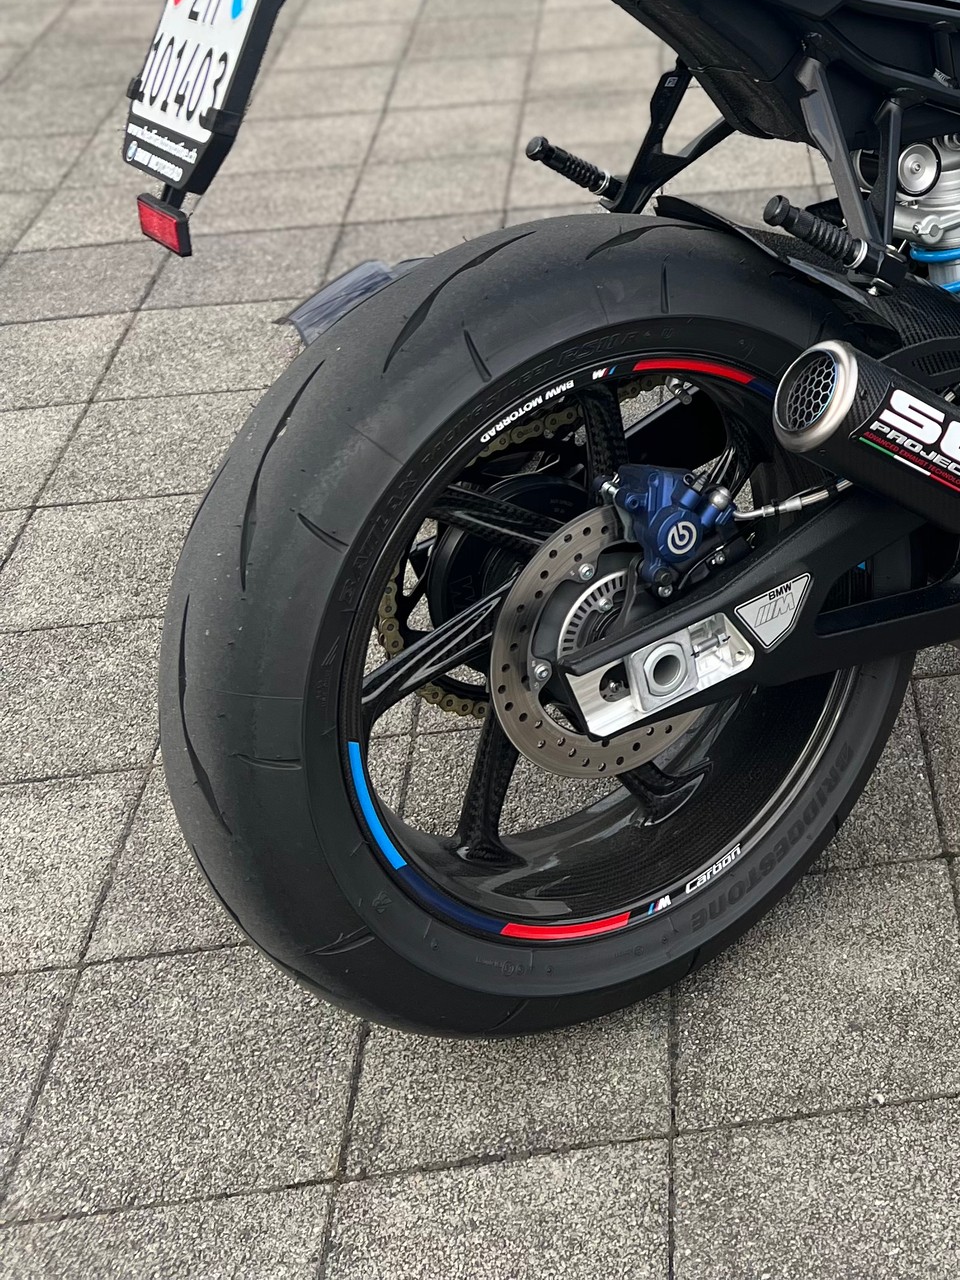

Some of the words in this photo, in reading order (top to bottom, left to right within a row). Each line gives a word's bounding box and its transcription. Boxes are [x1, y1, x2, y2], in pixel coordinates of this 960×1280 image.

[137, 31, 229, 122] 101403
[545, 379, 575, 400] BMW
[480, 395, 544, 443] MOTORRAD
[863, 431, 900, 455] ADVANCED
[898, 449, 928, 468] EXHAUST
[767, 581, 792, 601] BMW
[685, 842, 742, 894] Carbon
